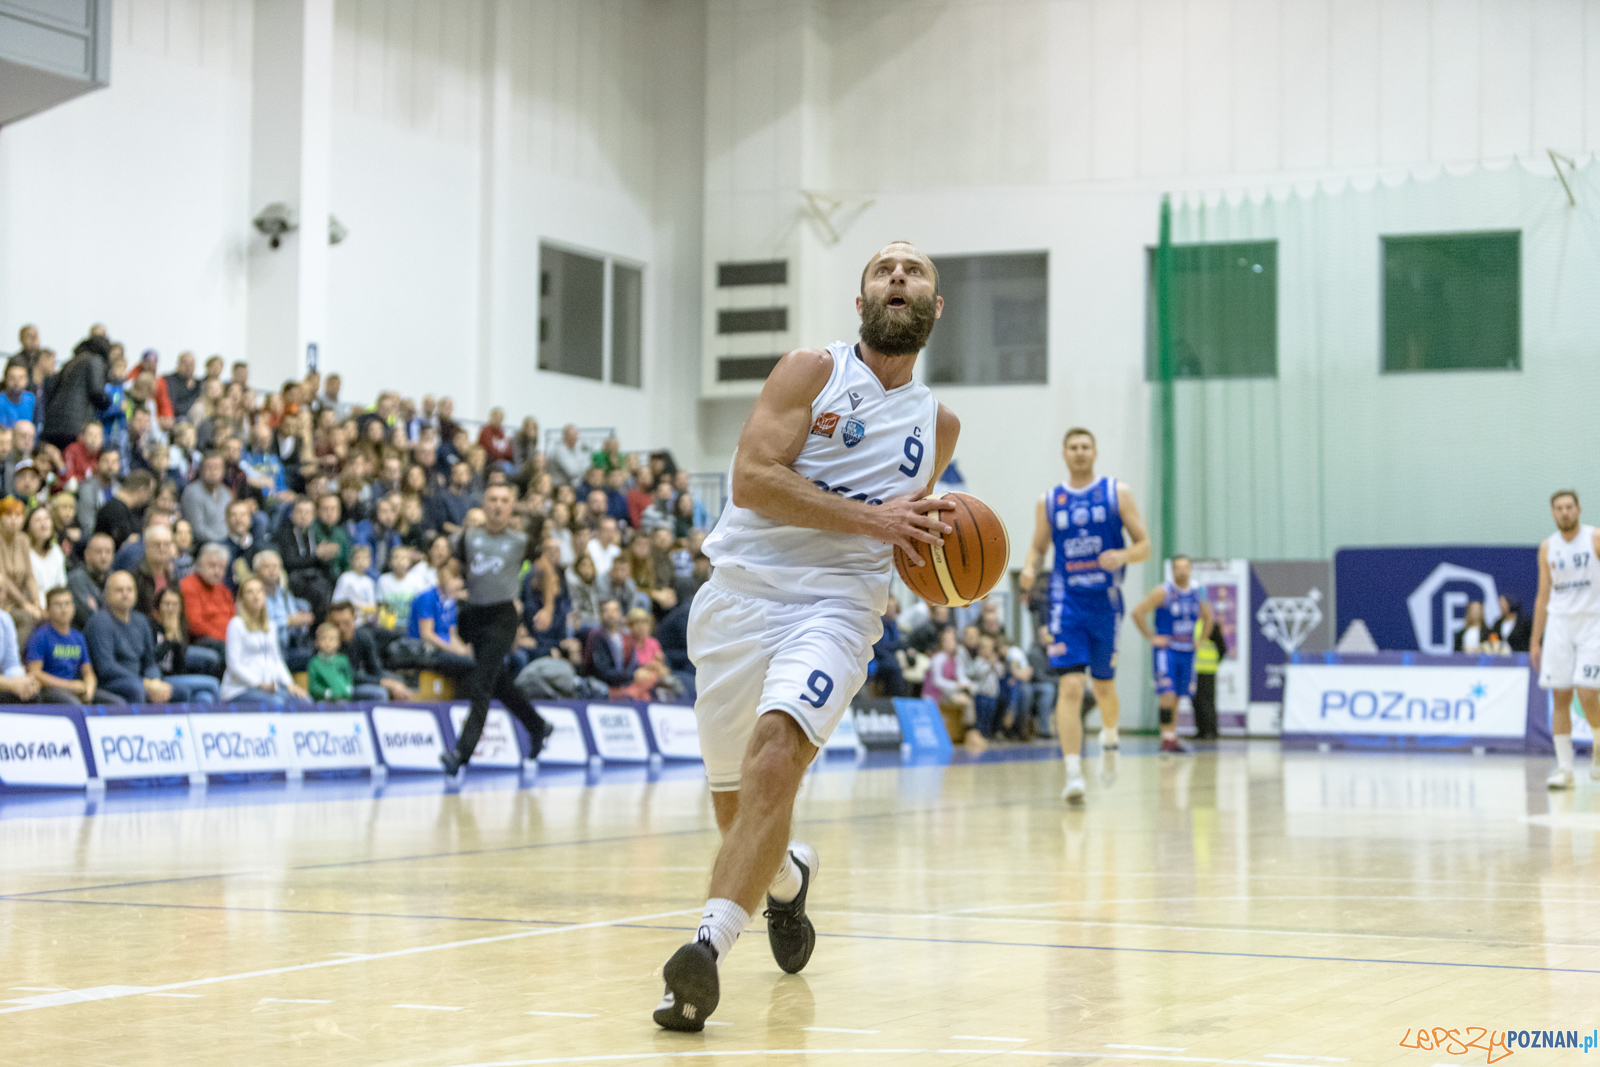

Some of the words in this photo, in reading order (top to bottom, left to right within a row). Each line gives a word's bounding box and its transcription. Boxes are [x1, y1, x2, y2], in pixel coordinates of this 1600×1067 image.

[913, 426, 921, 438] C
[899, 436, 924, 478] 9
[1573, 552, 1590, 568] 97
[1583, 664, 1600, 679] 97
[799, 669, 834, 709] 9
